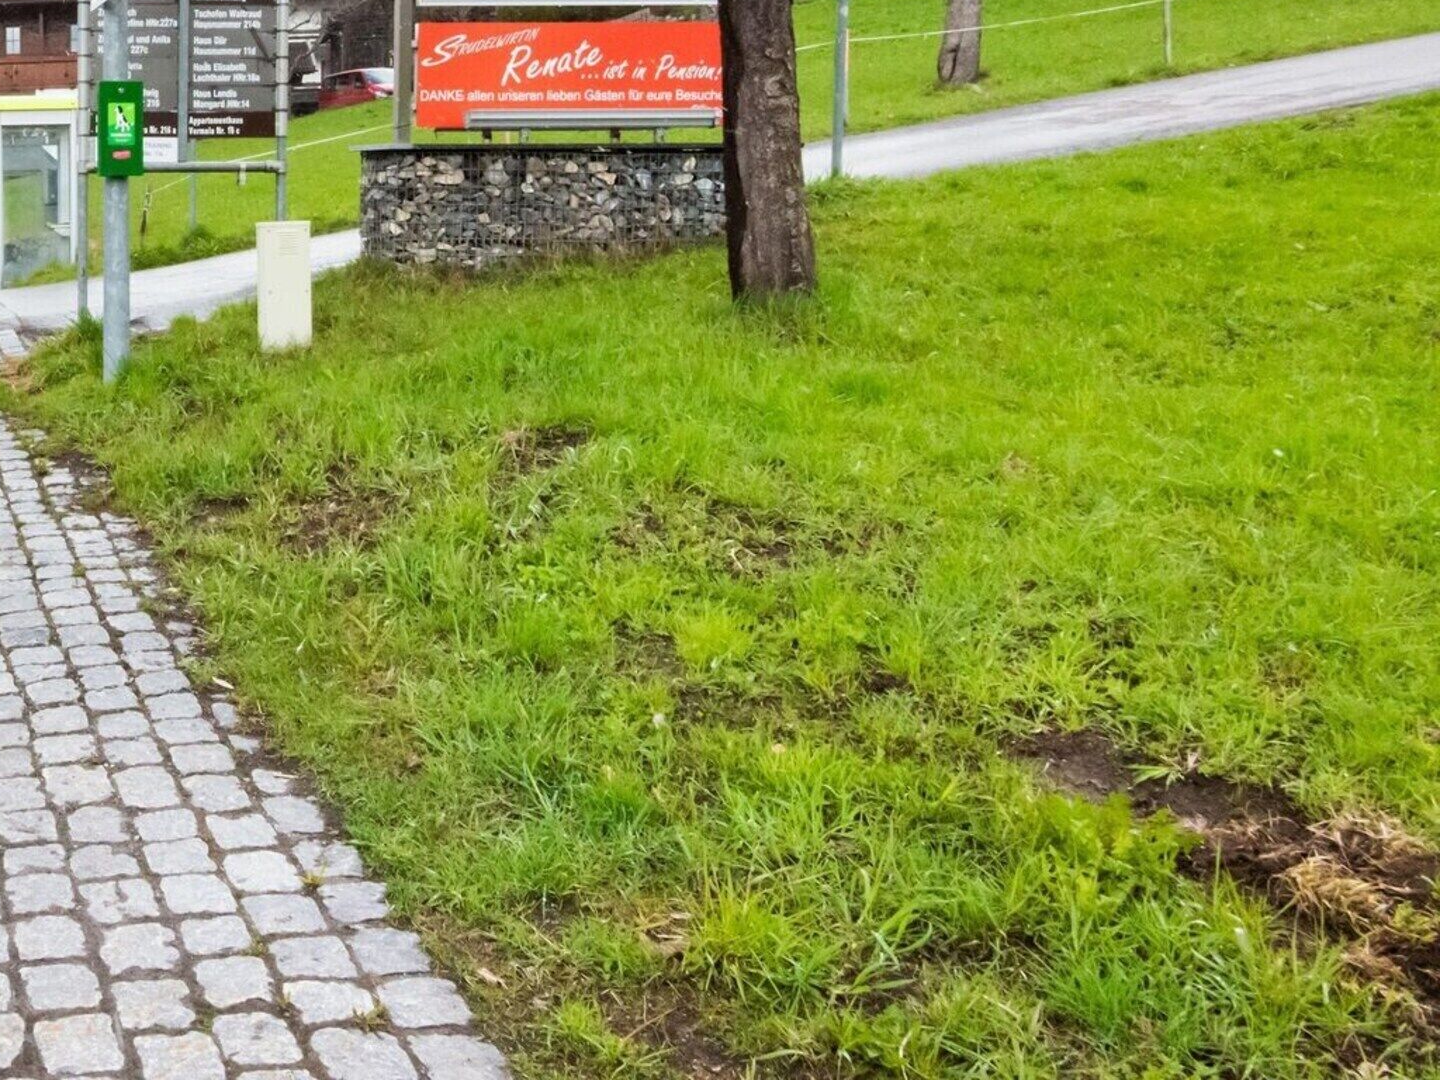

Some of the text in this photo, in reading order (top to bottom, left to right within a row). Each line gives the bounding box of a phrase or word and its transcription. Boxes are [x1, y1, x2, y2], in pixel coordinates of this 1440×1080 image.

[193, 35, 212, 45] Haus
[500, 37, 603, 87] Renate
[632, 59, 648, 81] in
[193, 89, 212, 99] Haus
[420, 89, 465, 102] DANKE
[467, 89, 495, 102] allen
[498, 90, 543, 102] unseren
[546, 89, 581, 102] lieben
[584, 88, 625, 102] Gästen
[627, 88, 643, 102] für
[646, 91, 672, 102] eure
